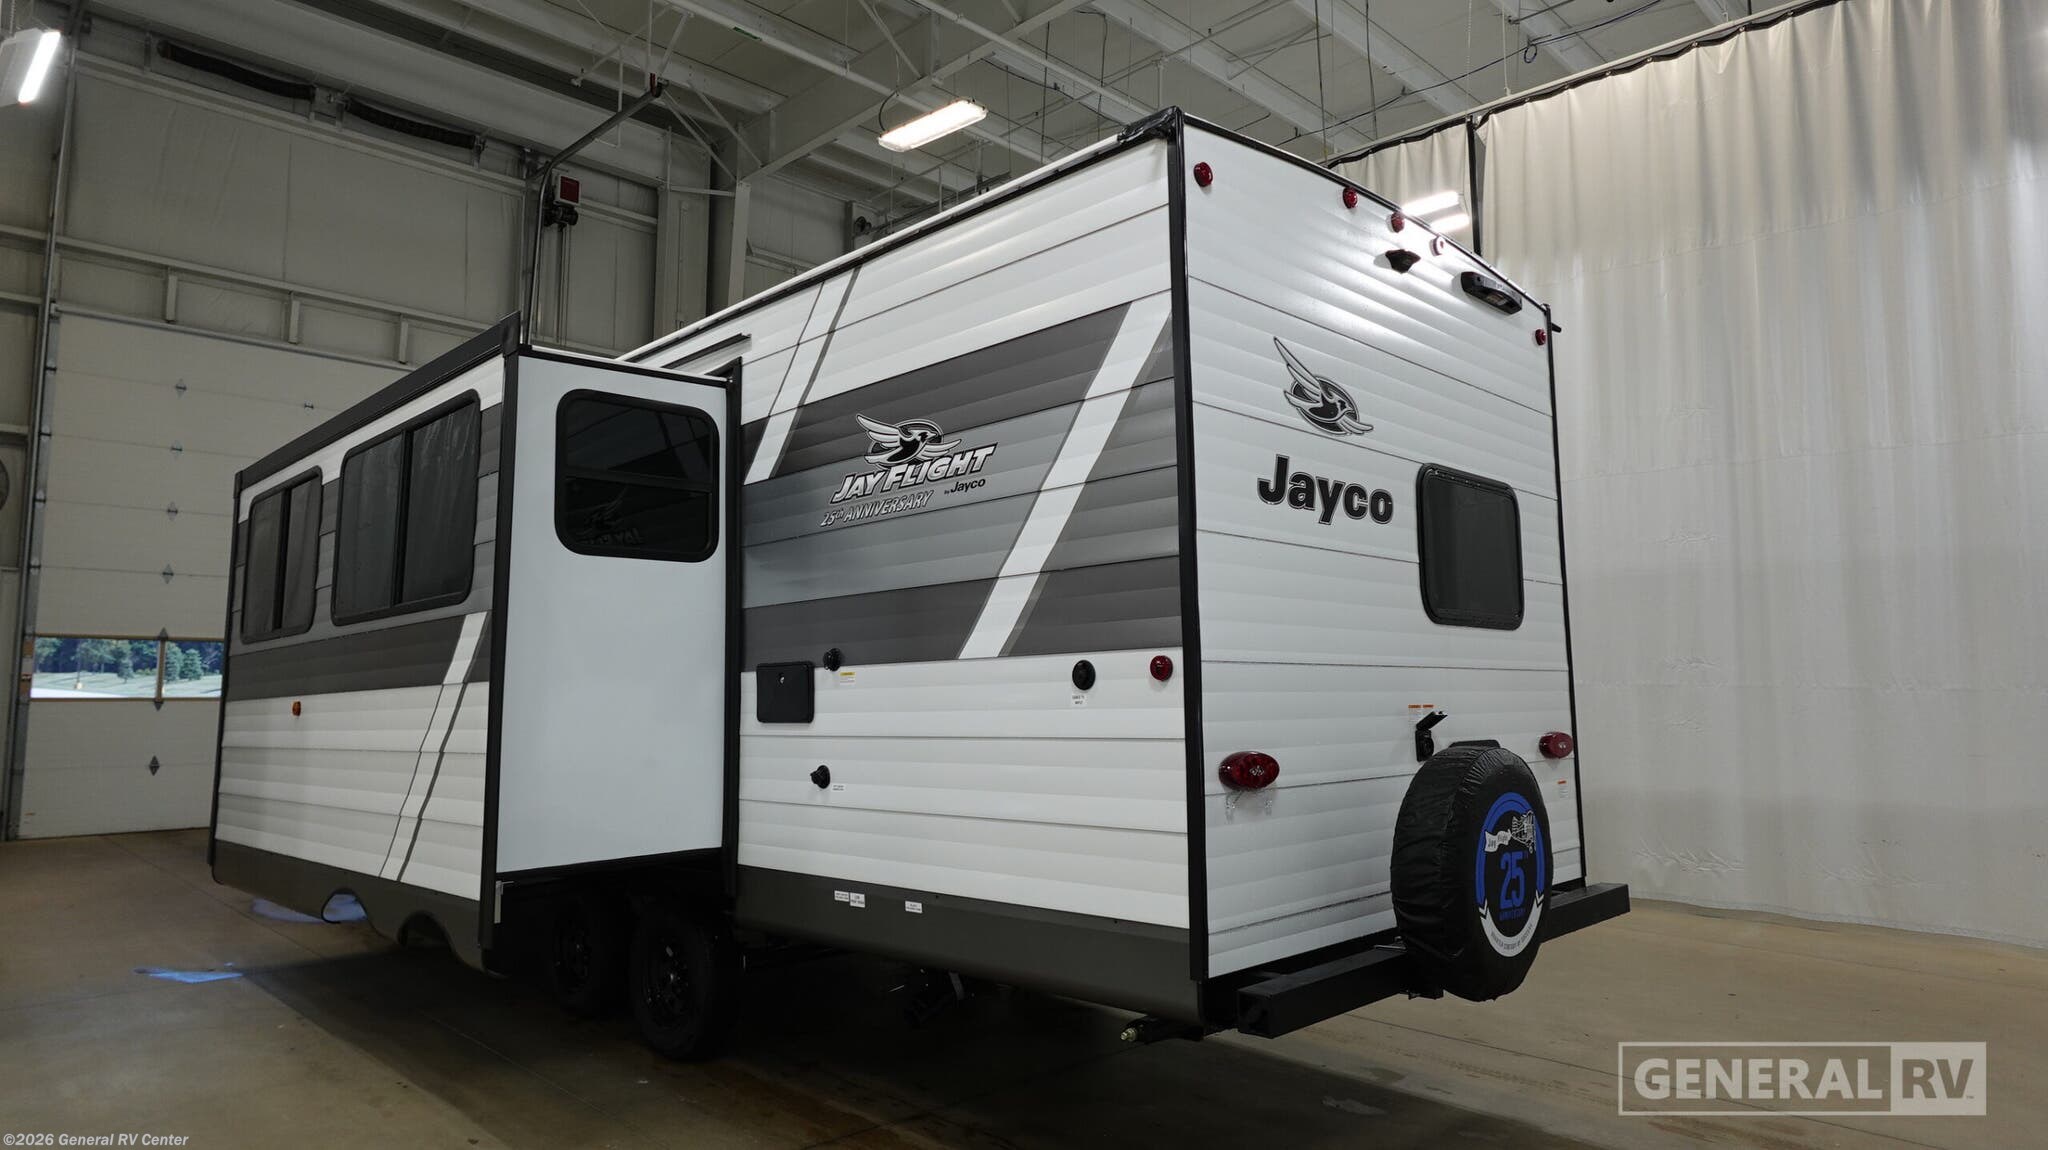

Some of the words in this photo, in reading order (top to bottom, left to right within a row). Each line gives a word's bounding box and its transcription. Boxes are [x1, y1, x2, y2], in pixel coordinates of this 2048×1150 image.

[830, 471, 886, 504] JAY
[881, 442, 998, 492] FLIGHT
[951, 478, 986, 494] Jayco
[1257, 454, 1394, 525] Jayco
[820, 509, 844, 527] 25th
[844, 489, 934, 523] ANNIVERSARY
